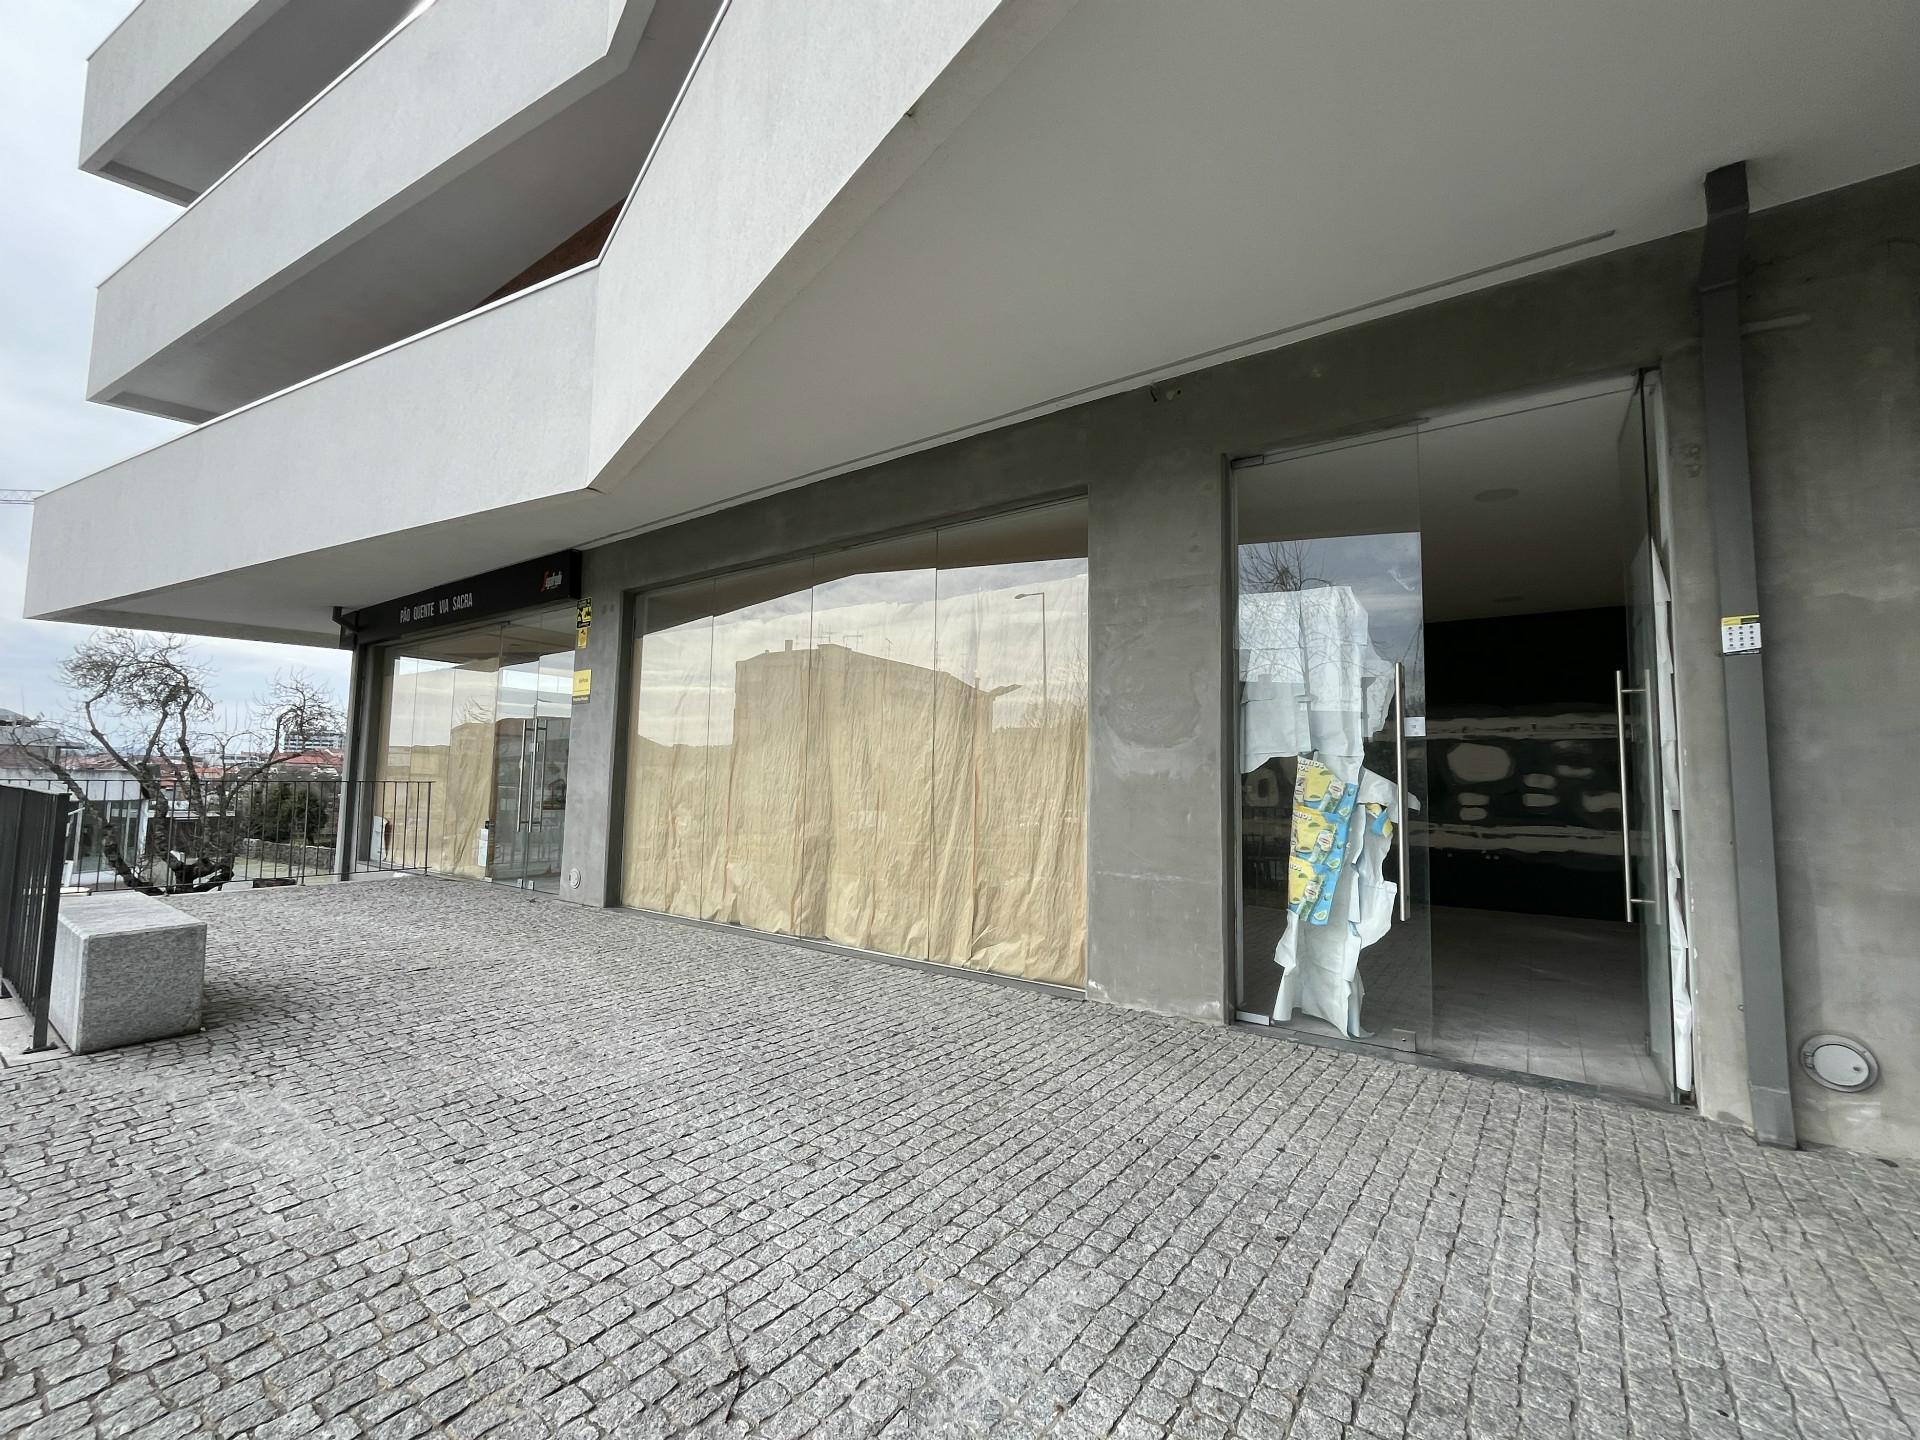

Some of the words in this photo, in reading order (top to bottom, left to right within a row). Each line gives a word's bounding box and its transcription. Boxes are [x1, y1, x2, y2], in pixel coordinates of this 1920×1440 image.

[399, 607, 411, 624] PÃO
[413, 602, 435, 621] QUENTE
[439, 598, 449, 614] VIA
[452, 592, 473, 611] SACRA
